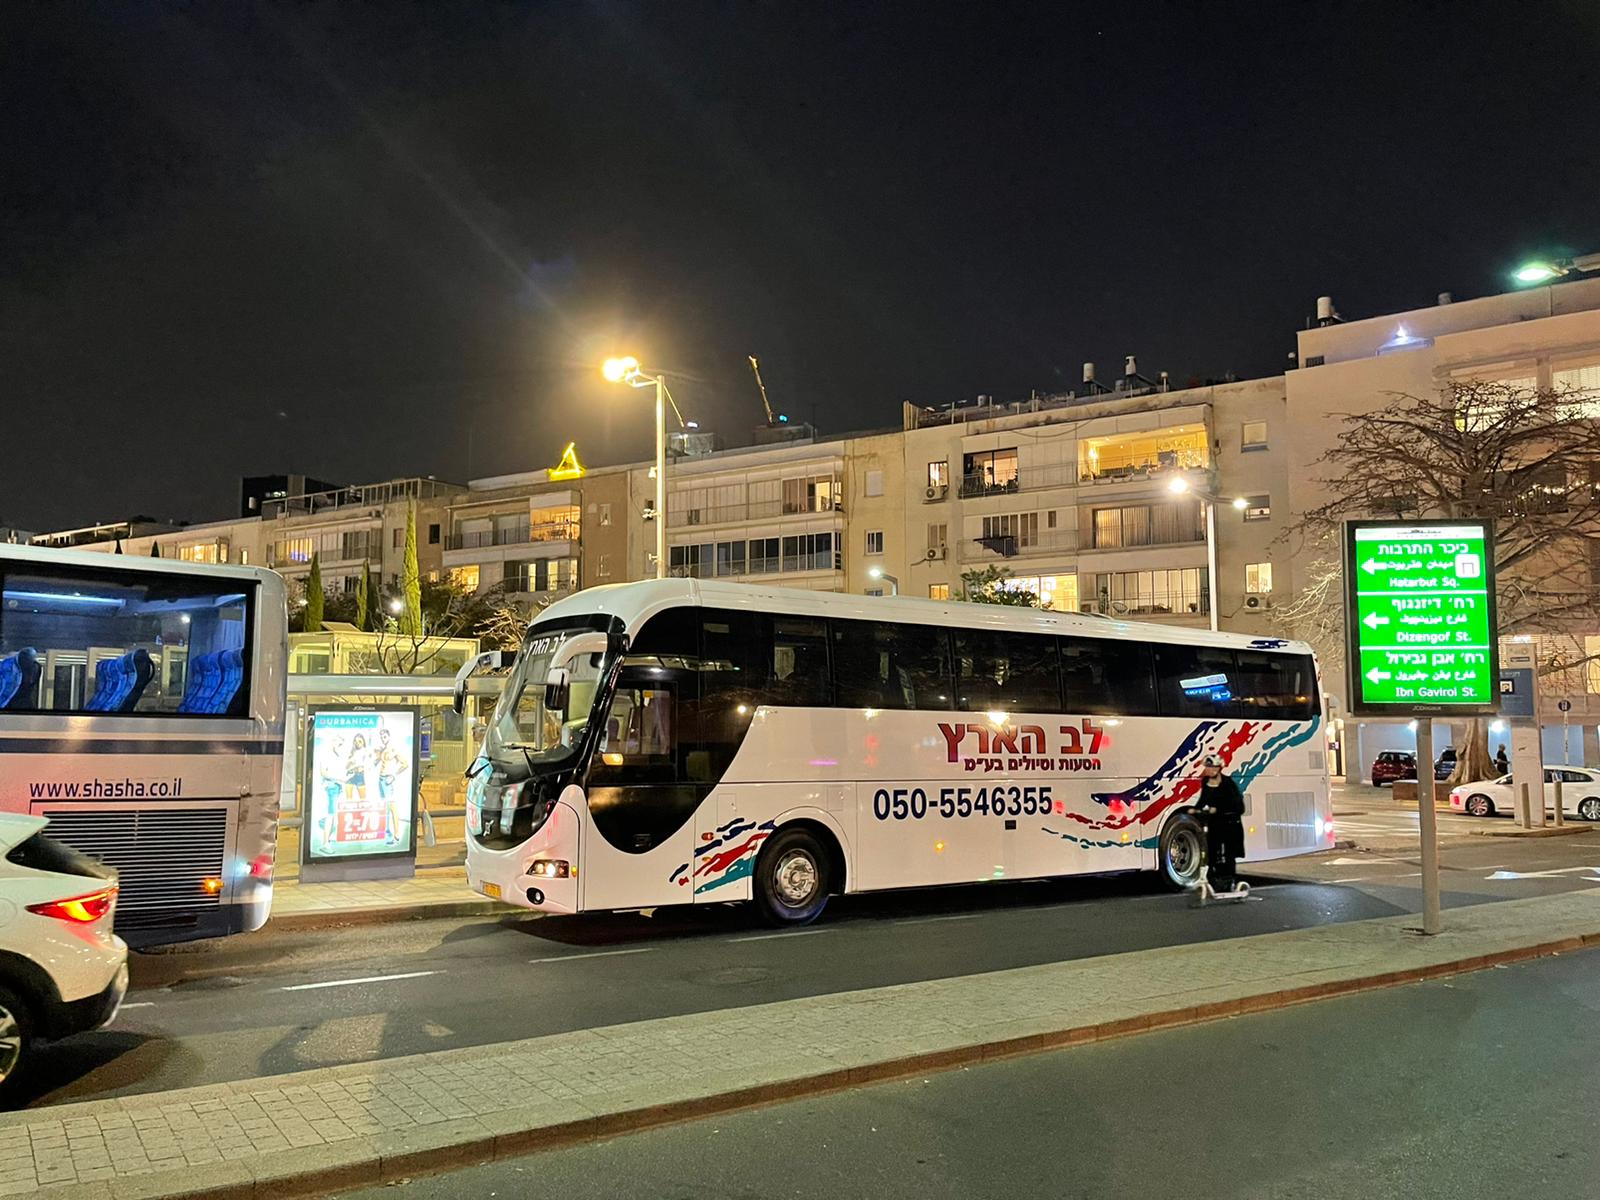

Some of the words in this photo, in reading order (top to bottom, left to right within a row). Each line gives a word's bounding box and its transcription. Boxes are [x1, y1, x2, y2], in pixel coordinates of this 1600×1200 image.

[1378, 544, 1433, 555] התרבות
[1438, 543, 1469, 554] כיכר
[1442, 577, 1460, 589] Sq.
[1391, 598, 1441, 612] דיזנגוף
[1396, 632, 1450, 644] Dizengof
[1455, 632, 1472, 642] St.
[525, 637, 551, 661] הארץ
[1385, 651, 1428, 664] גבירול
[1432, 653, 1455, 666] אבן
[1395, 687, 1414, 697] Ibn
[1418, 687, 1457, 697] Gavirol
[1462, 687, 1477, 697] St.
[937, 723, 1047, 763] הארץ
[1059, 718, 1103, 755] לב
[1058, 758, 1101, 772] הסעות
[30, 778, 182, 798] www.shasha.co.il
[873, 786, 1053, 821] 050-5546355
